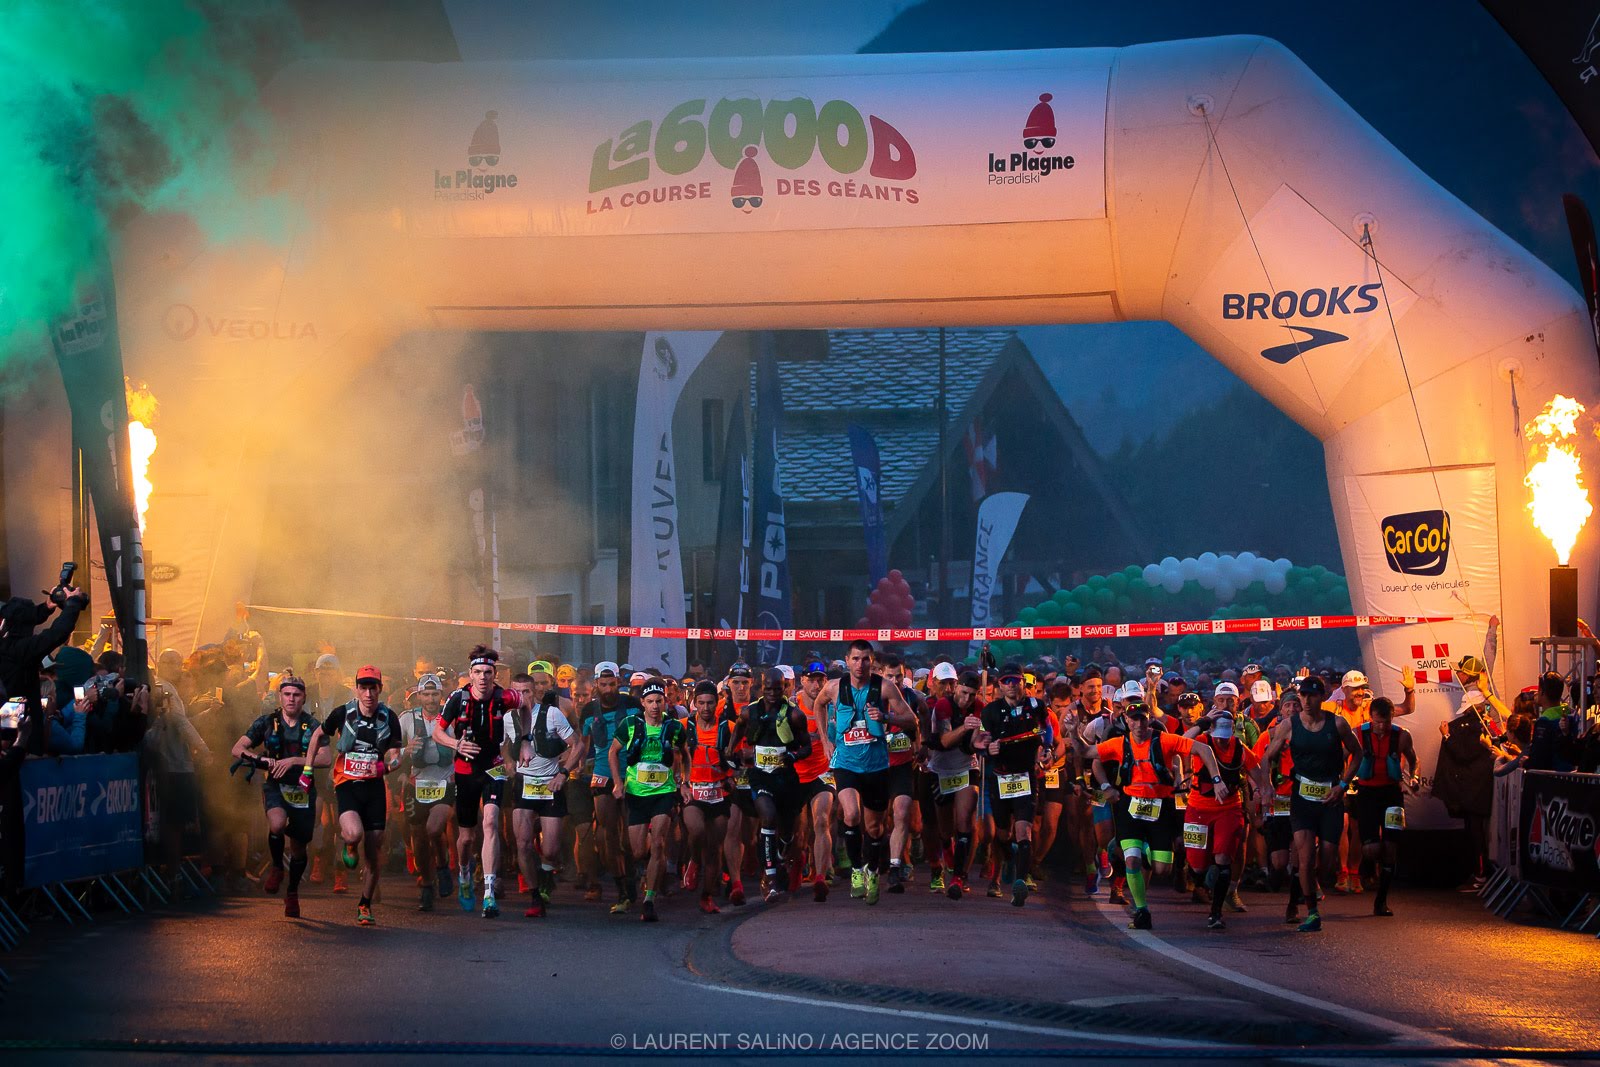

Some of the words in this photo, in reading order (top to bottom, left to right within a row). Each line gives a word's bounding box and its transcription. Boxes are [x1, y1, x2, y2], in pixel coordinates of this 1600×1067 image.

[988, 152, 1006, 173] la
[1010, 151, 1075, 176] Plagne
[434, 169, 452, 189] la
[456, 168, 518, 194] Plagne
[988, 172, 1041, 185] Paradiski
[586, 187, 614, 215] LA
[620, 181, 712, 208] COURSE
[776, 178, 822, 196] DES
[827, 178, 920, 204] GÉANTS
[1222, 283, 1382, 320] BROOKS
[204, 316, 319, 340] VEOLIA
[1381, 583, 1409, 593] Loueur
[1411, 582, 1423, 592] de
[1425, 579, 1470, 591] véhicules
[608, 626, 638, 635] SAVOIE
[799, 631, 827, 639] SAVOIE
[893, 630, 922, 638] SAVOIE
[989, 628, 1018, 637] SAVOIE
[1084, 626, 1113, 635] SAVOIE
[1180, 622, 1209, 632] SAVOIE
[1276, 618, 1305, 628] SAVOIE
[1416, 658, 1447, 669] SAVOIE
[1418, 686, 1464, 694] DÉPARTEMEN
[421, 788, 440, 797] 1511
[1006, 782, 1022, 791] 588
[1304, 786, 1325, 795] 1095
[37, 783, 88, 824] BROOKS
[106, 778, 139, 815] BROOKS
